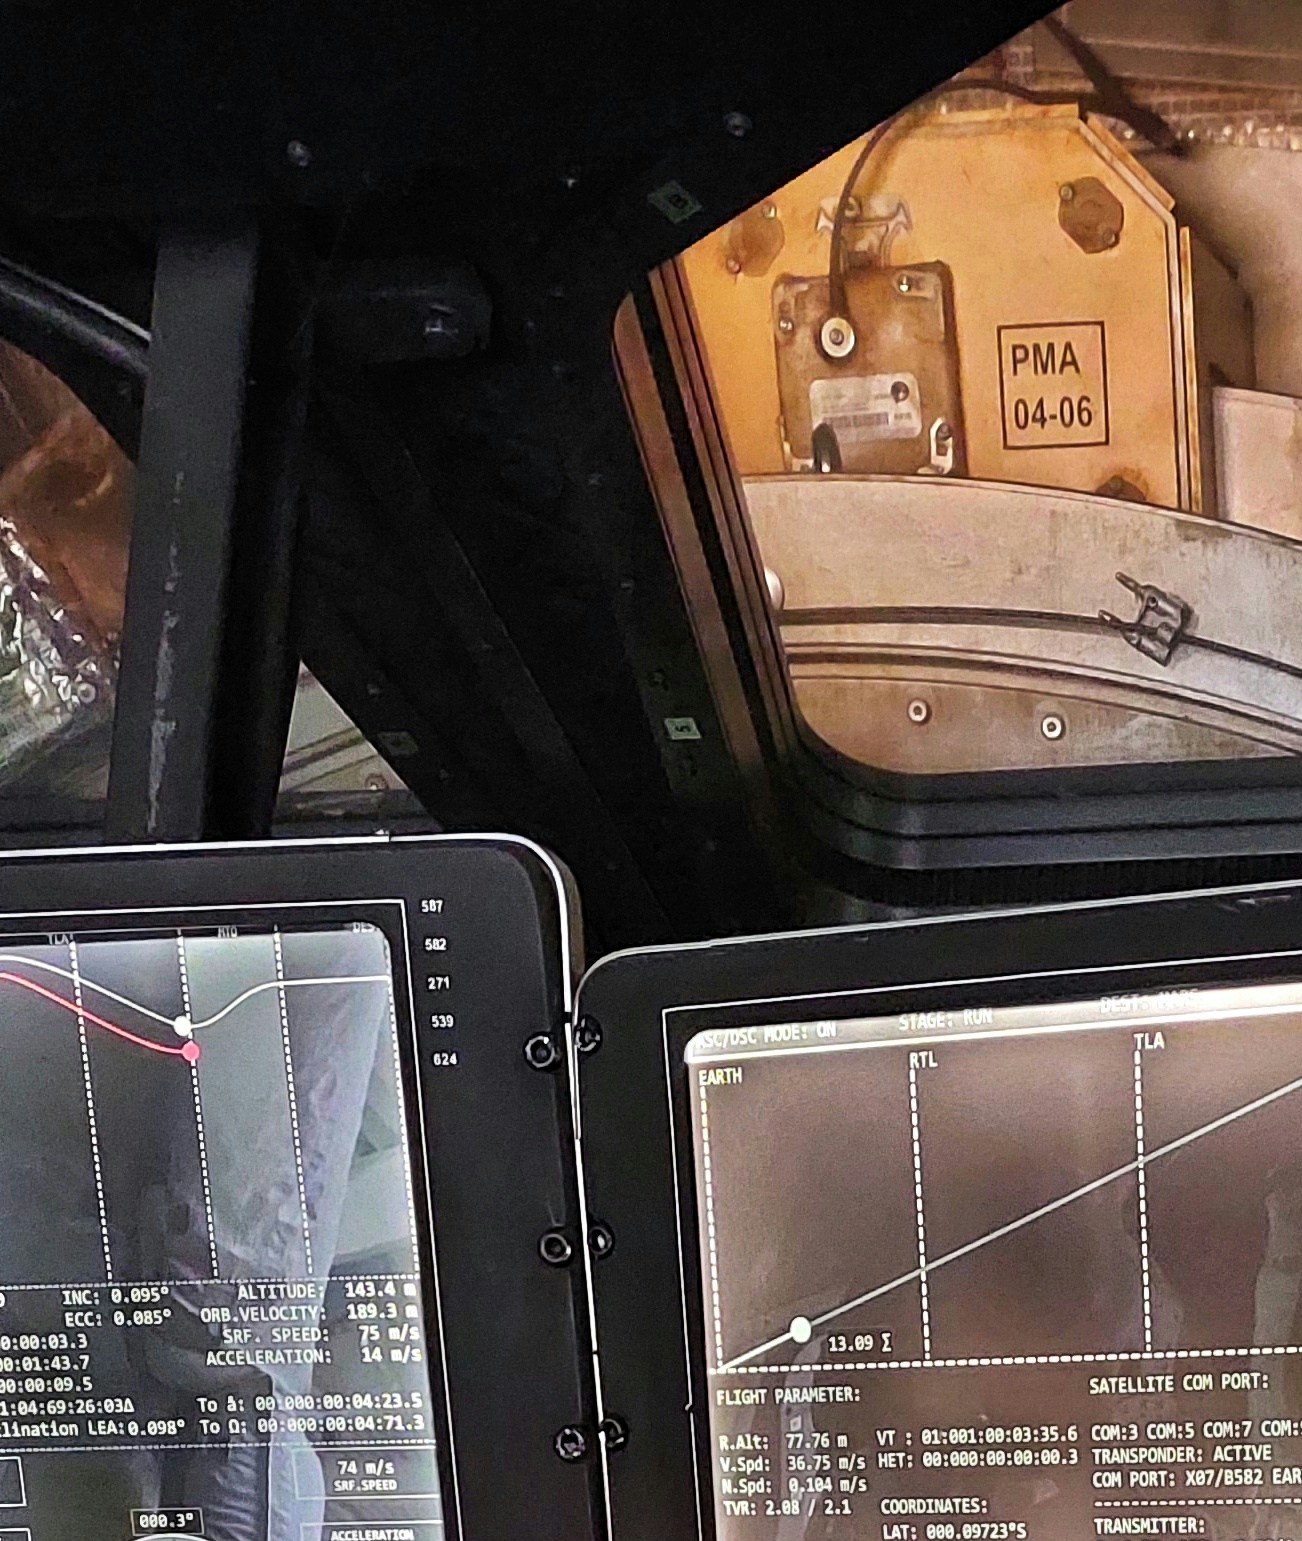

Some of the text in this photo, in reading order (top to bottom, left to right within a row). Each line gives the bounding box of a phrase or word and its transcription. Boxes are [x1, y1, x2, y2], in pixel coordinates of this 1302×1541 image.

[1010, 341, 1081, 377] PMA
[1013, 396, 1094, 431] 04-06
[425, 938, 447, 951] 582
[428, 976, 450, 990] 271
[431, 1014, 454, 1028] 539
[900, 1009, 992, 1031] STAGE: RUN
[764, 1025, 808, 1043] MODE:
[817, 1023, 836, 1038] ON
[1134, 1034, 1164, 1049] TLA
[433, 1053, 457, 1066] 624
[910, 1052, 938, 1068] RTL
[699, 1068, 742, 1086] EARTH
[62, 1291, 100, 1306] INC:
[238, 1282, 396, 1300] ALTITUDE: 143.4
[65, 1313, 102, 1327] ECC:
[201, 1304, 398, 1323] ORB.VELOCITY: 189.3
[223, 1326, 420, 1344] SRF. SPEED: 75 m/s
[828, 1336, 874, 1352] 13.09
[207, 1347, 421, 1366] ACCELERATION: 14 m/s
[1090, 1373, 1269, 1395] SATELLITE COM PORT:
[717, 1387, 860, 1406] FLIGHT PARAMETER:
[1091, 1423, 1138, 1441] COM:3
[1146, 1422, 1195, 1440] COM:5
[1203, 1421, 1251, 1438] COM:7
[719, 1433, 847, 1451] R.Alt: 77.76 m
[720, 1454, 866, 1473] V.Spd: 36.75 m/s
[878, 1453, 913, 1468] HET:
[1092, 1445, 1271, 1465] TRANSPONDER: ACTIVE
[337, 1460, 394, 1475] 74 m/s
[1093, 1471, 1122, 1488] COM
[1130, 1470, 1176, 1487] PORT:
[1185, 1468, 1264, 1488] X07/B582
[881, 1498, 987, 1514] COORDINATES:
[331, 1529, 414, 1541] ACCELERATION
[883, 1525, 917, 1540] LAT:
[1094, 1518, 1205, 1534] TRANSMITTER:
